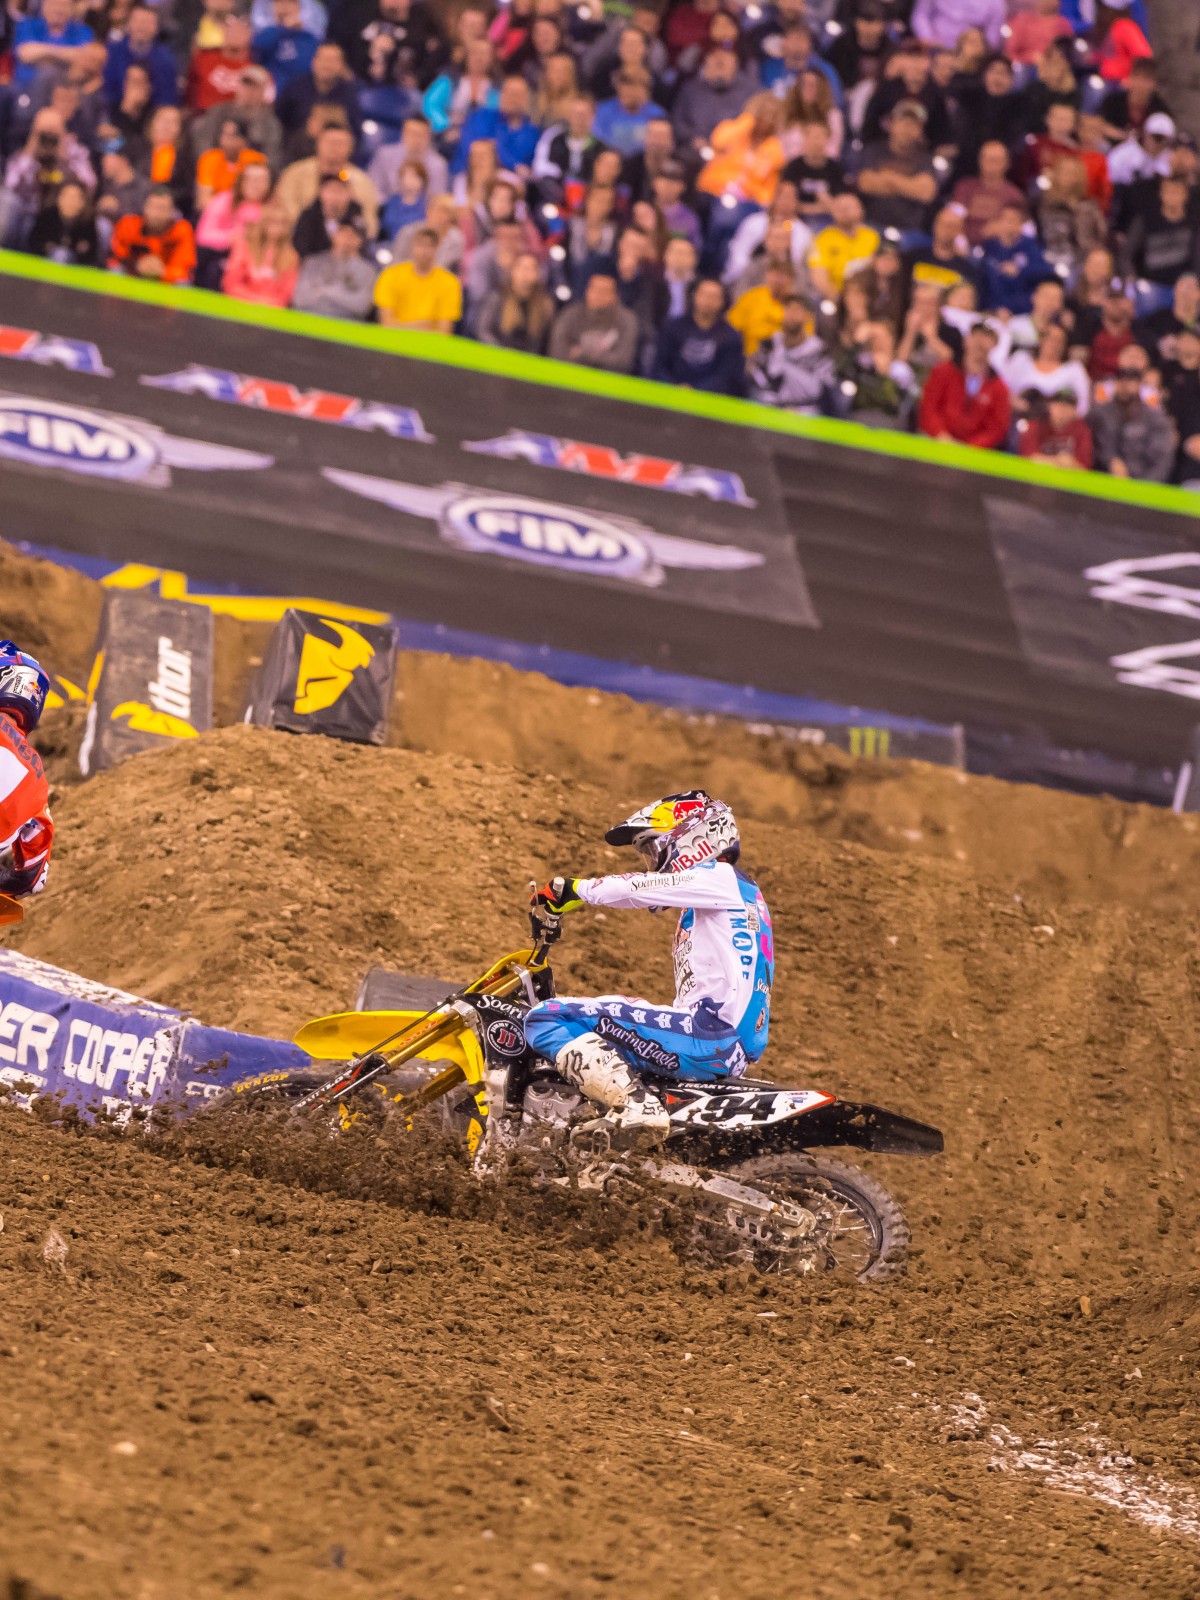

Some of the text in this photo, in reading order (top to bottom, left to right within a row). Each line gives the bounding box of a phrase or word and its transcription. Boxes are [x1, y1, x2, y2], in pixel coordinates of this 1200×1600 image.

[475, 511, 622, 561] FIM
[147, 635, 192, 719] thor
[700, 1092, 780, 1123] 94
